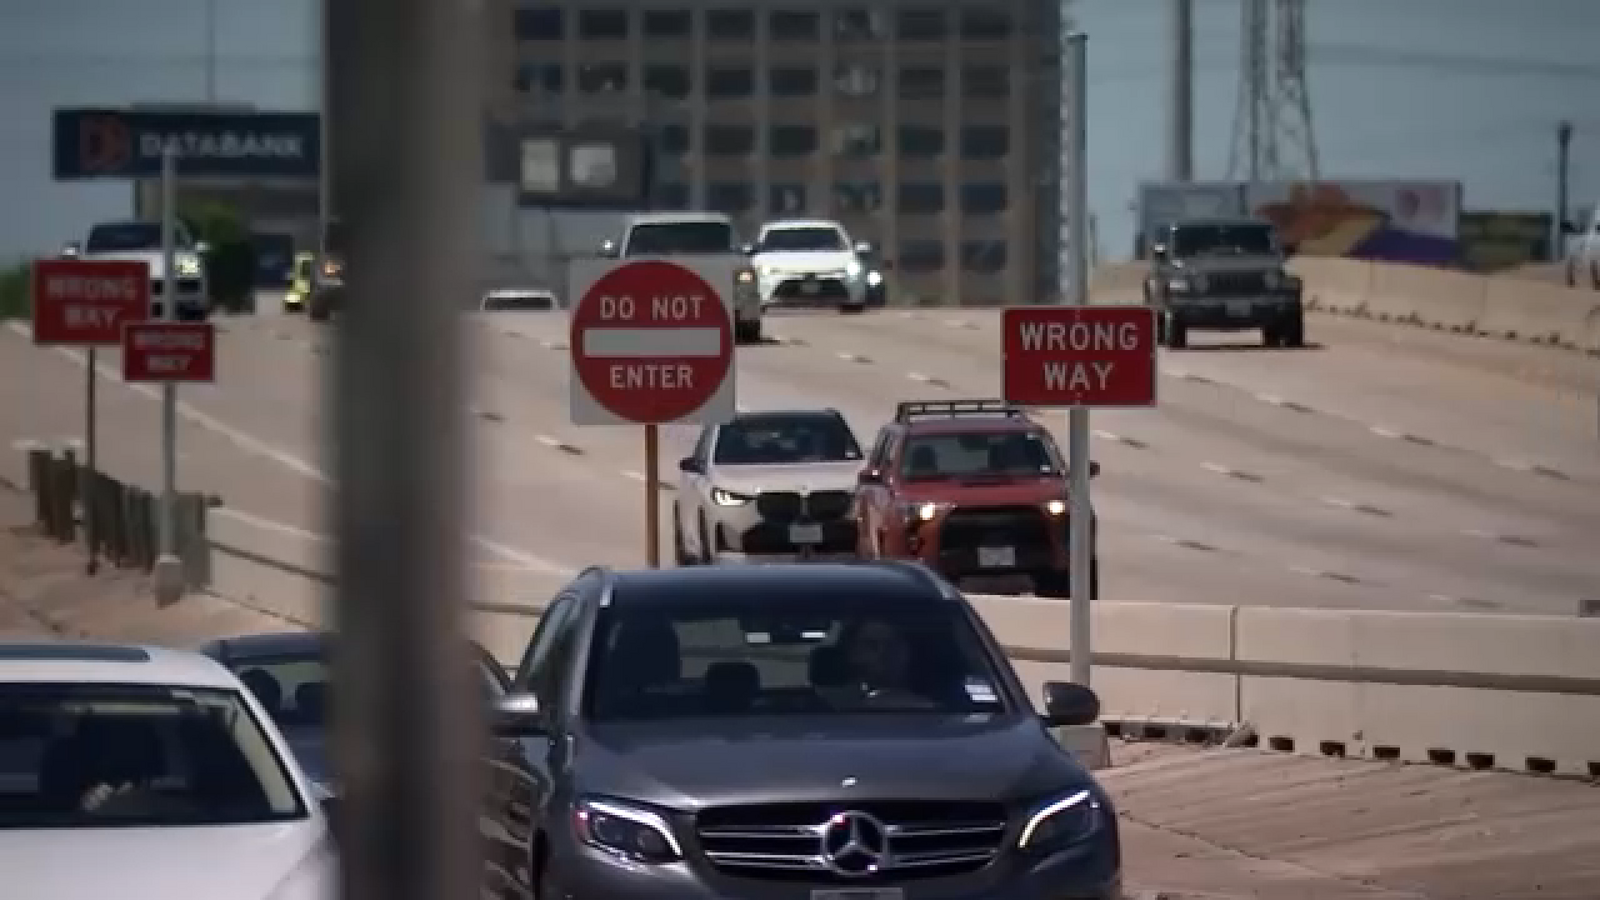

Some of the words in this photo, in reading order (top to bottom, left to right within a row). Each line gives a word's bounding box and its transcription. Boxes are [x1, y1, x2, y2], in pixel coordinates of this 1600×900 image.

[599, 295, 636, 320] DO
[650, 295, 706, 320] NOT
[1019, 321, 1140, 350] WRONG
[609, 364, 694, 391] ENTER
[1042, 360, 1116, 391] WAY
